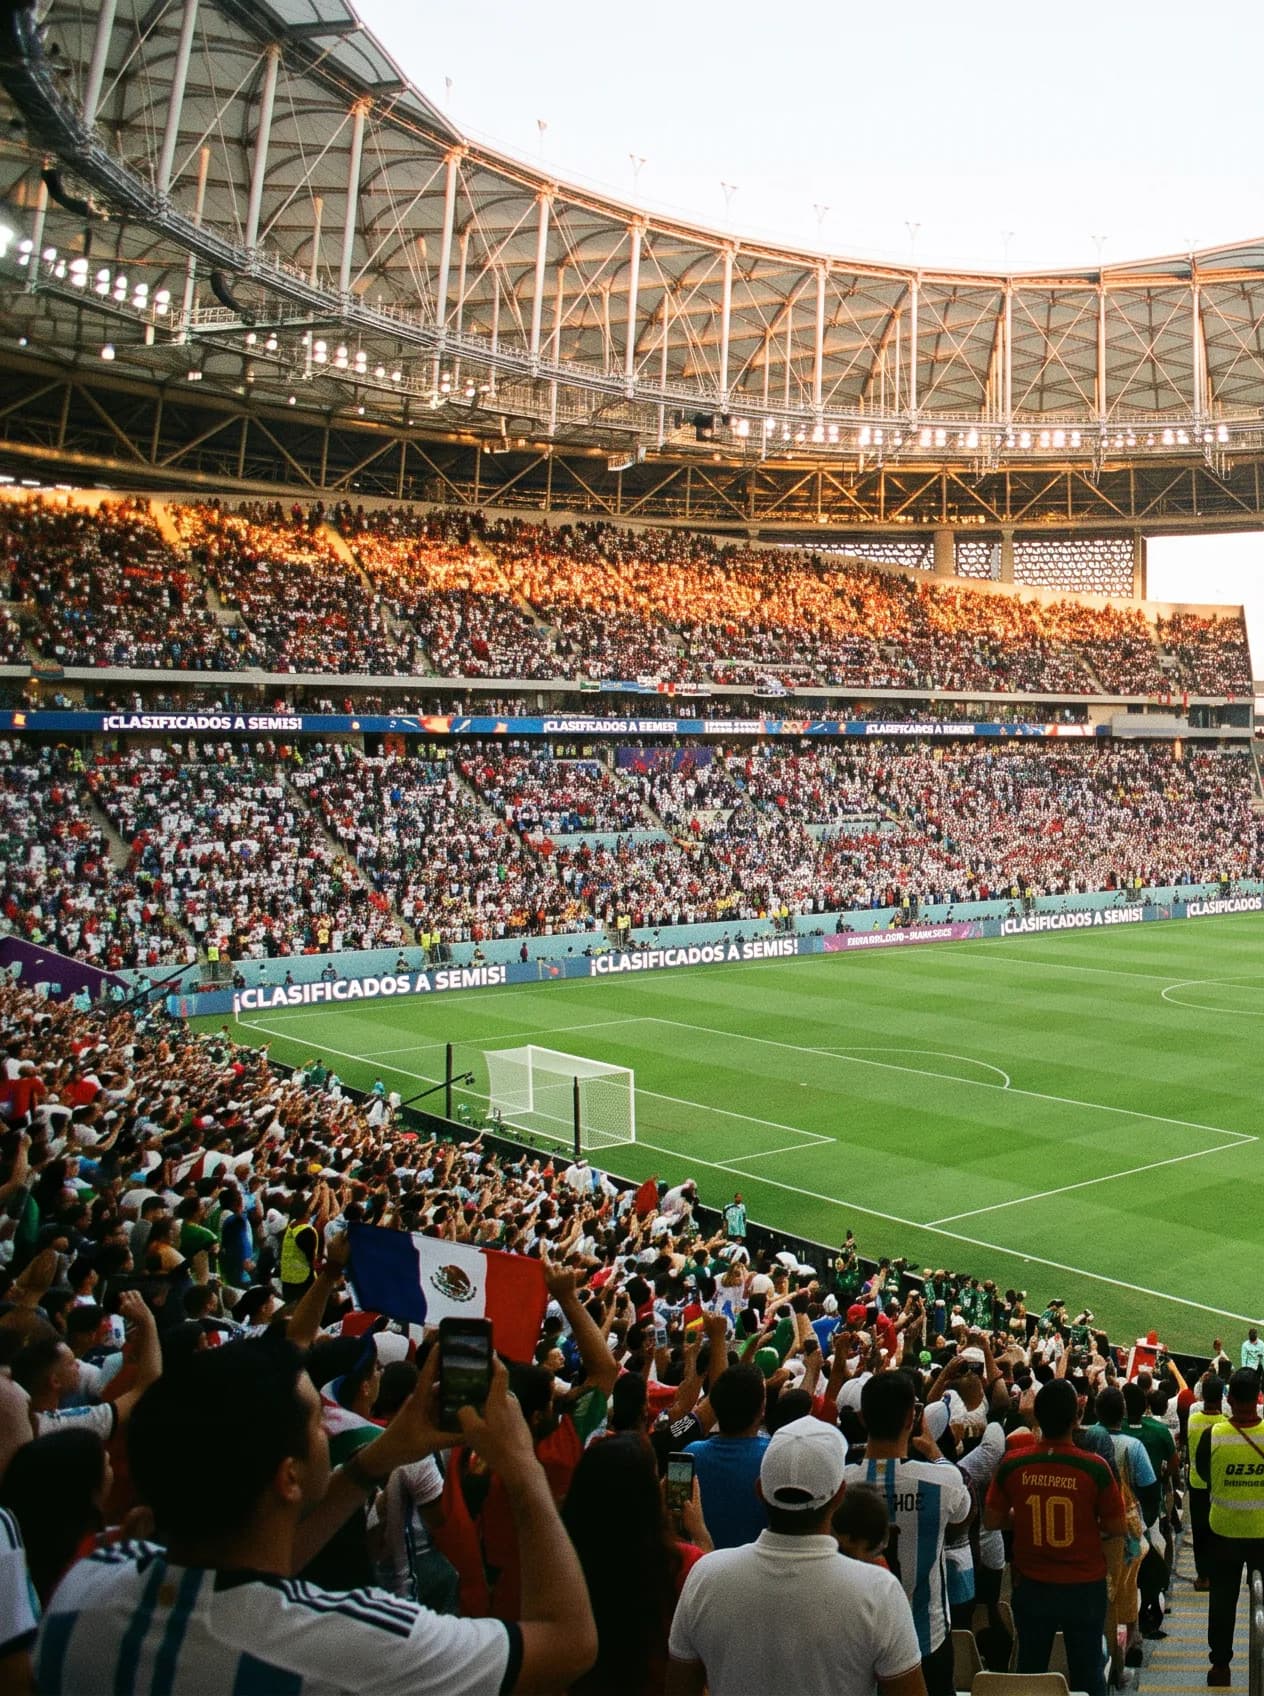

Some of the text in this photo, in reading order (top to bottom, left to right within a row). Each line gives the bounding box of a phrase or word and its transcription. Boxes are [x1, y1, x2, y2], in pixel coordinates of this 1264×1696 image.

[103, 716, 303, 730] ¡CLASIFICADOS A SEMIS!
[628, 722, 638, 731] A
[1000, 911, 1092, 936] ¡CLASIFICADOS
[1094, 911, 1103, 925] A
[590, 939, 799, 977] ¡CLASIFICADOS A SEMIS!
[233, 966, 507, 1012] ¡CLASIFICADOS A SEMIS!
[1025, 1494, 1075, 1548] 10
